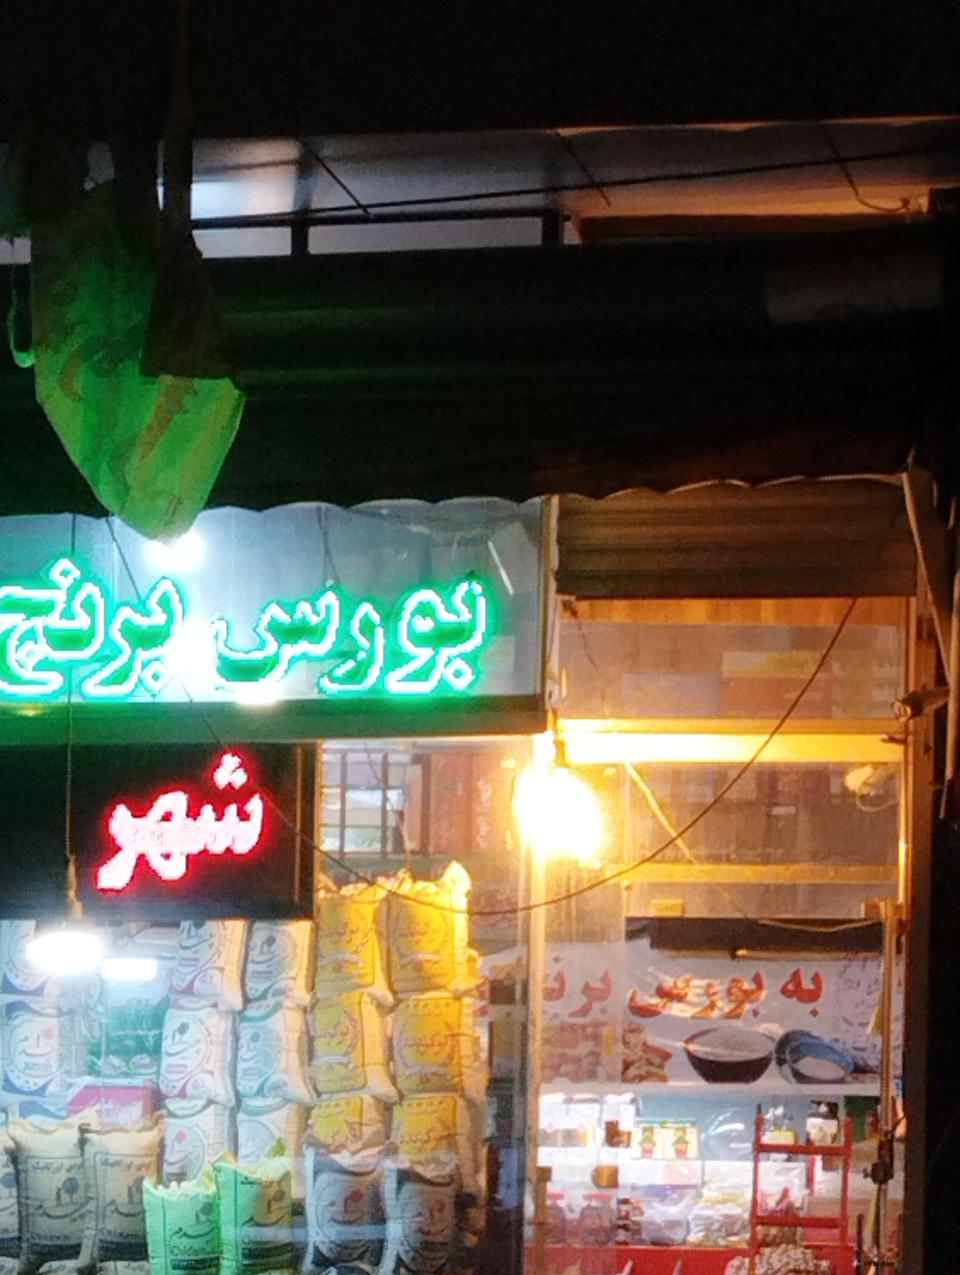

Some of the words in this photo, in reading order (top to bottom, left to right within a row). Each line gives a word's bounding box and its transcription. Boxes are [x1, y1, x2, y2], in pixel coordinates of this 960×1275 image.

[210, 578, 487, 694] بورس
[95, 752, 264, 891] شهر
[542, 954, 614, 1019] برن
[779, 966, 824, 1018] به
